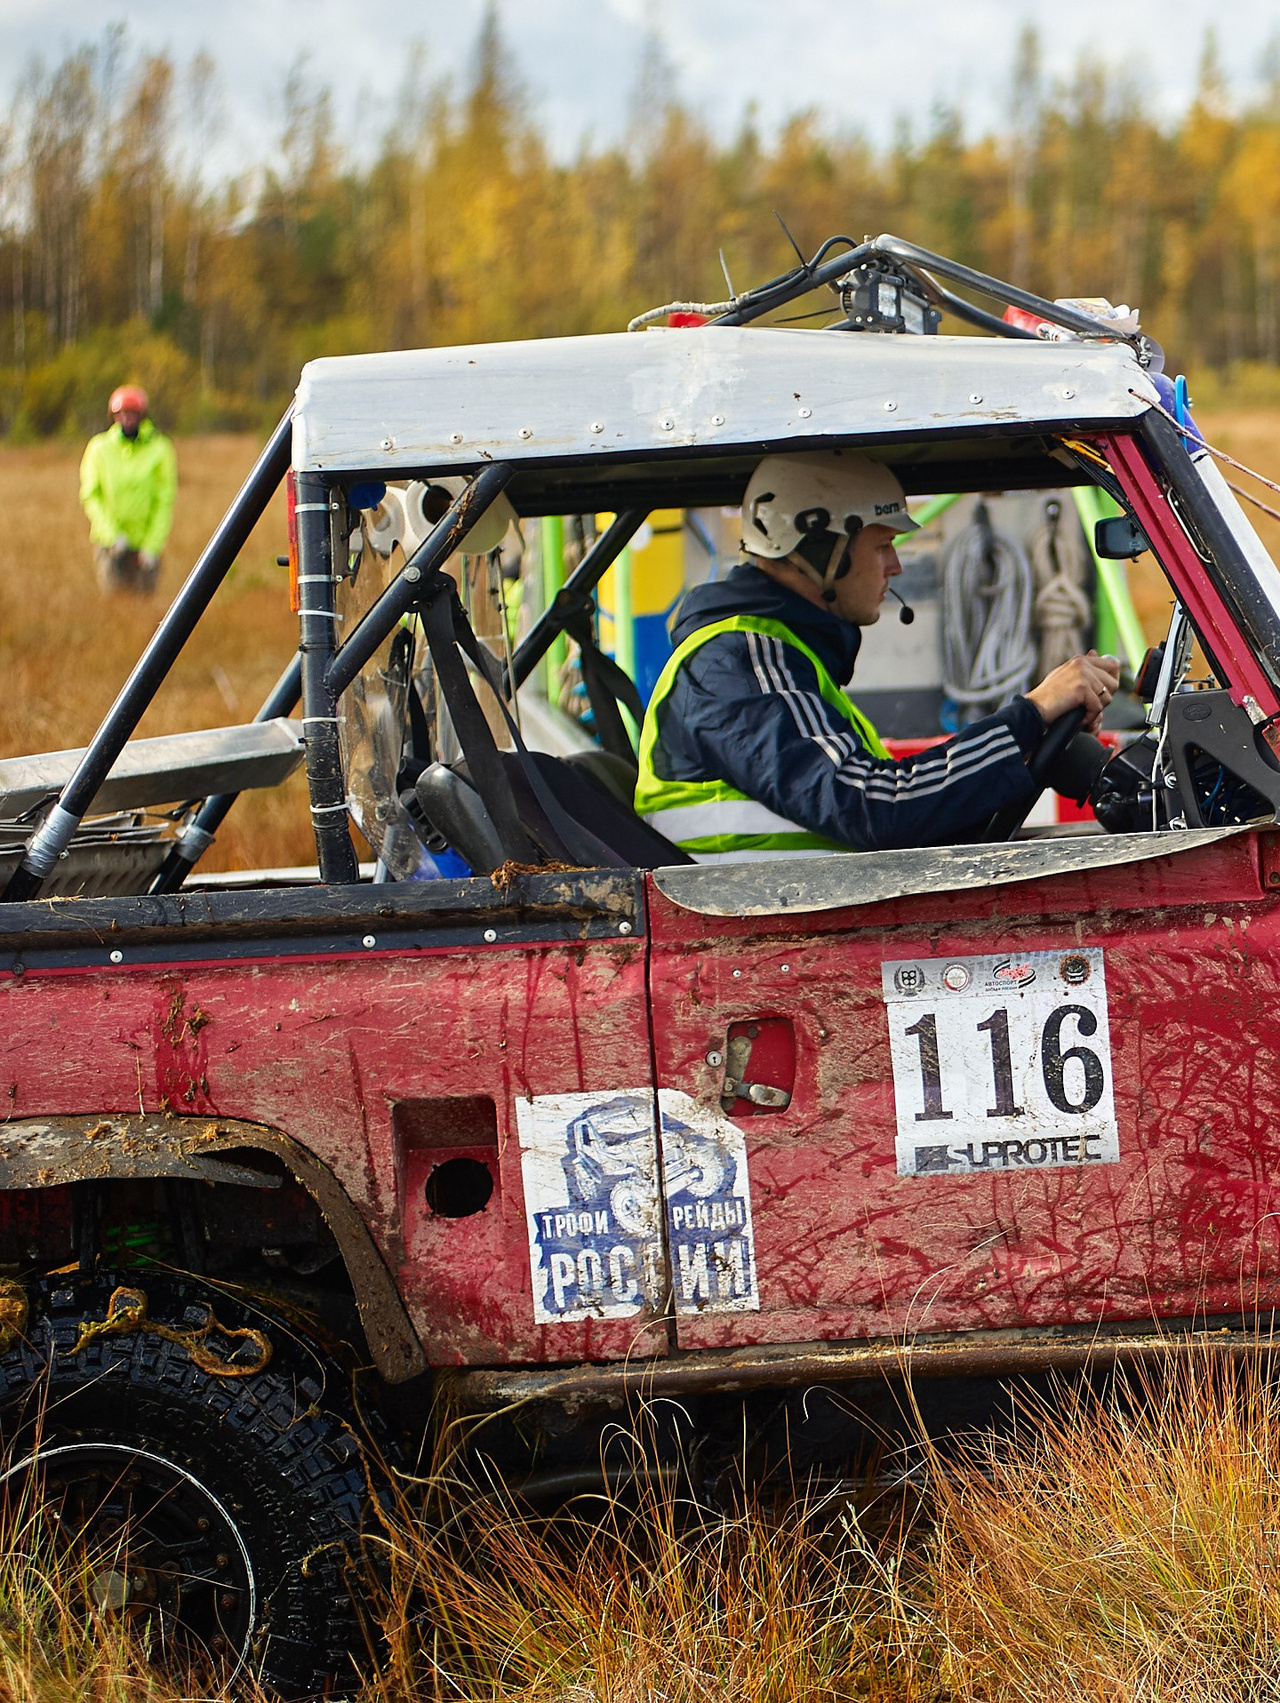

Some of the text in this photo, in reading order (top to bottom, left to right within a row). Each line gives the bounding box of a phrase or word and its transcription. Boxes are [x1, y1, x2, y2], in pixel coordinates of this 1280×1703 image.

[874, 502, 900, 516] bern
[905, 1004, 1104, 1121] 116
[947, 1135, 1101, 1168] SUPROTEC
[542, 1210, 609, 1240] ТРОФИ
[672, 1199, 744, 1231] РЕЙДЫ
